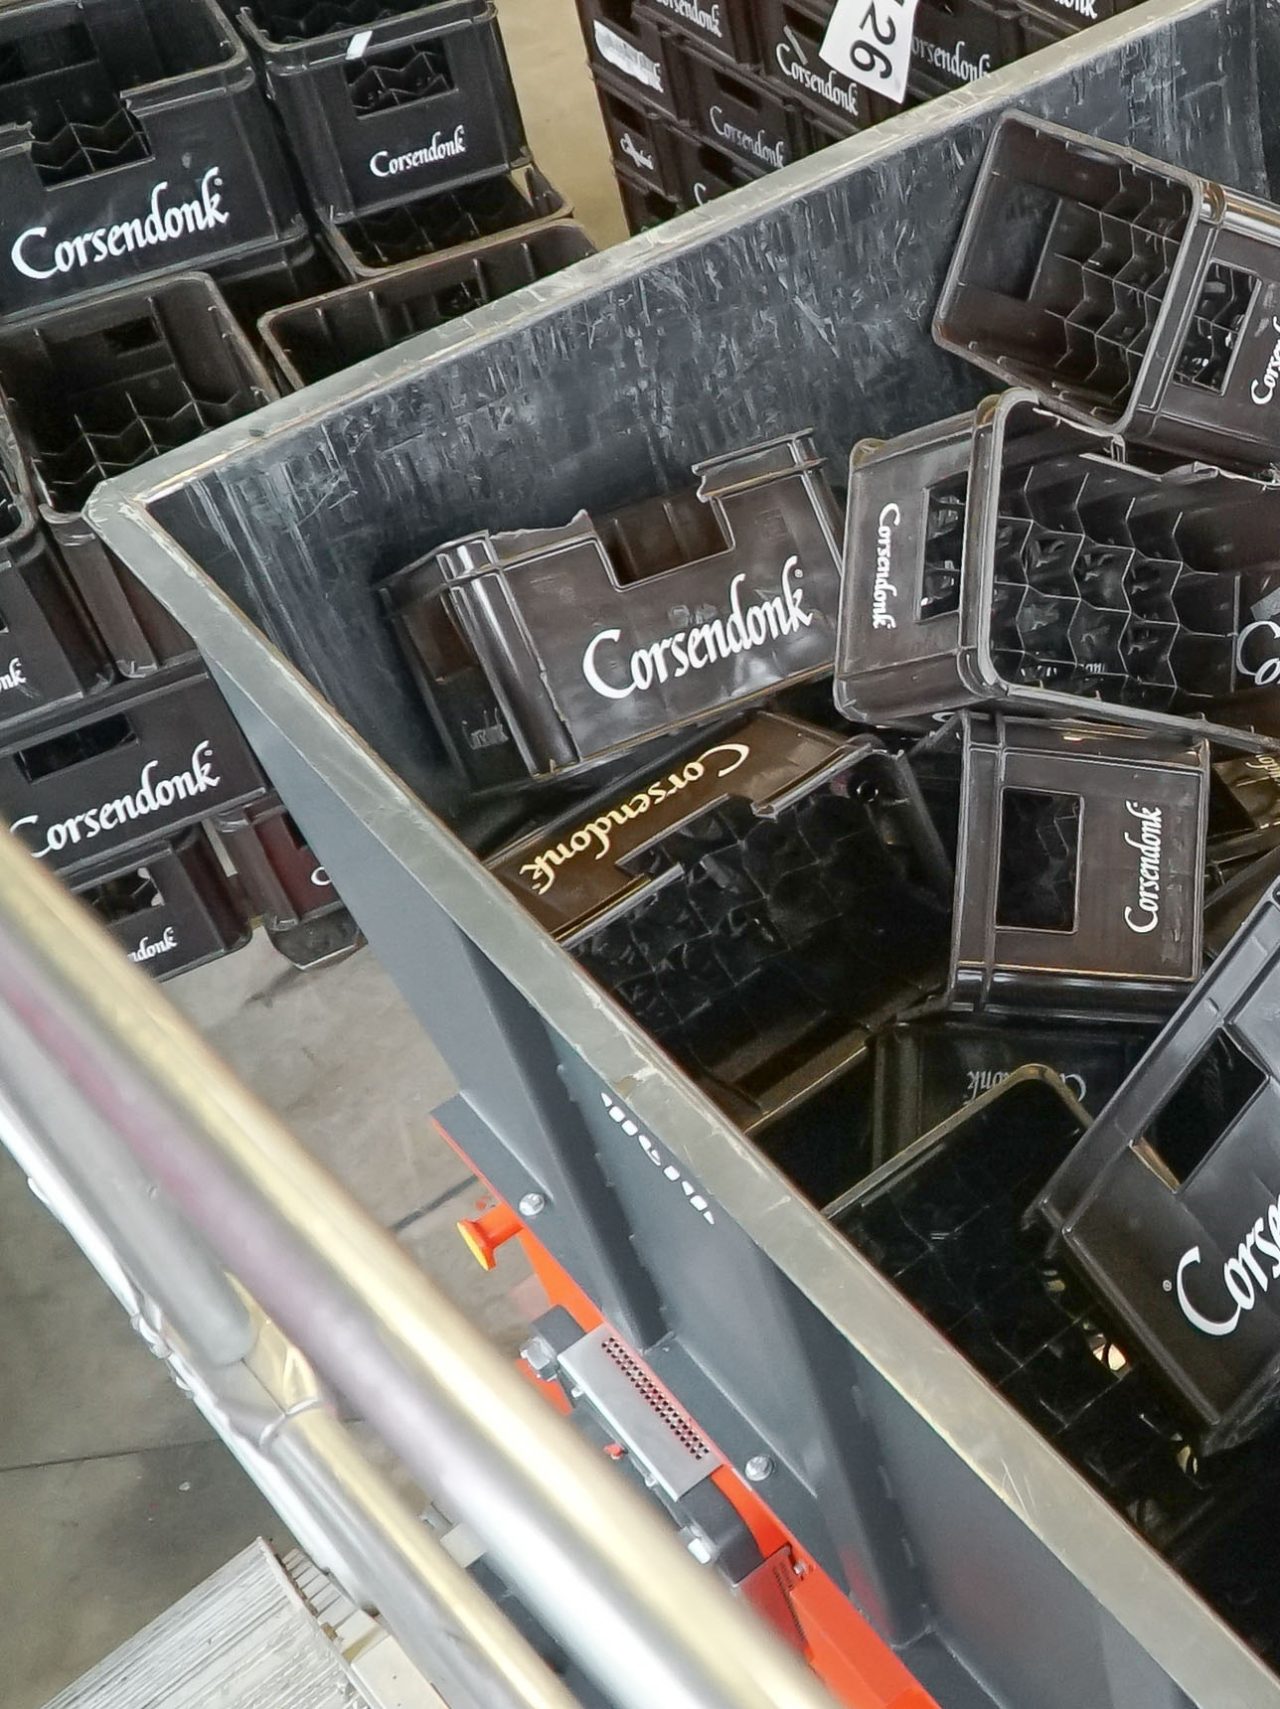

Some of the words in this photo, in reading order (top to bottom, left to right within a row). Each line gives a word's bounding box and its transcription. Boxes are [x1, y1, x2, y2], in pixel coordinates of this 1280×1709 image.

[775, 43, 860, 116] Corsendonk
[849, 0, 905, 79] 26
[369, 125, 467, 178] Corsendonk
[11, 167, 229, 279] Corsendonk
[870, 502, 902, 629] Corsendonk
[581, 555, 812, 699] Corsendonk
[10, 740, 220, 859] Corsendonk
[518, 743, 752, 895] Corsendonk
[1124, 804, 1162, 935] Corsendonk
